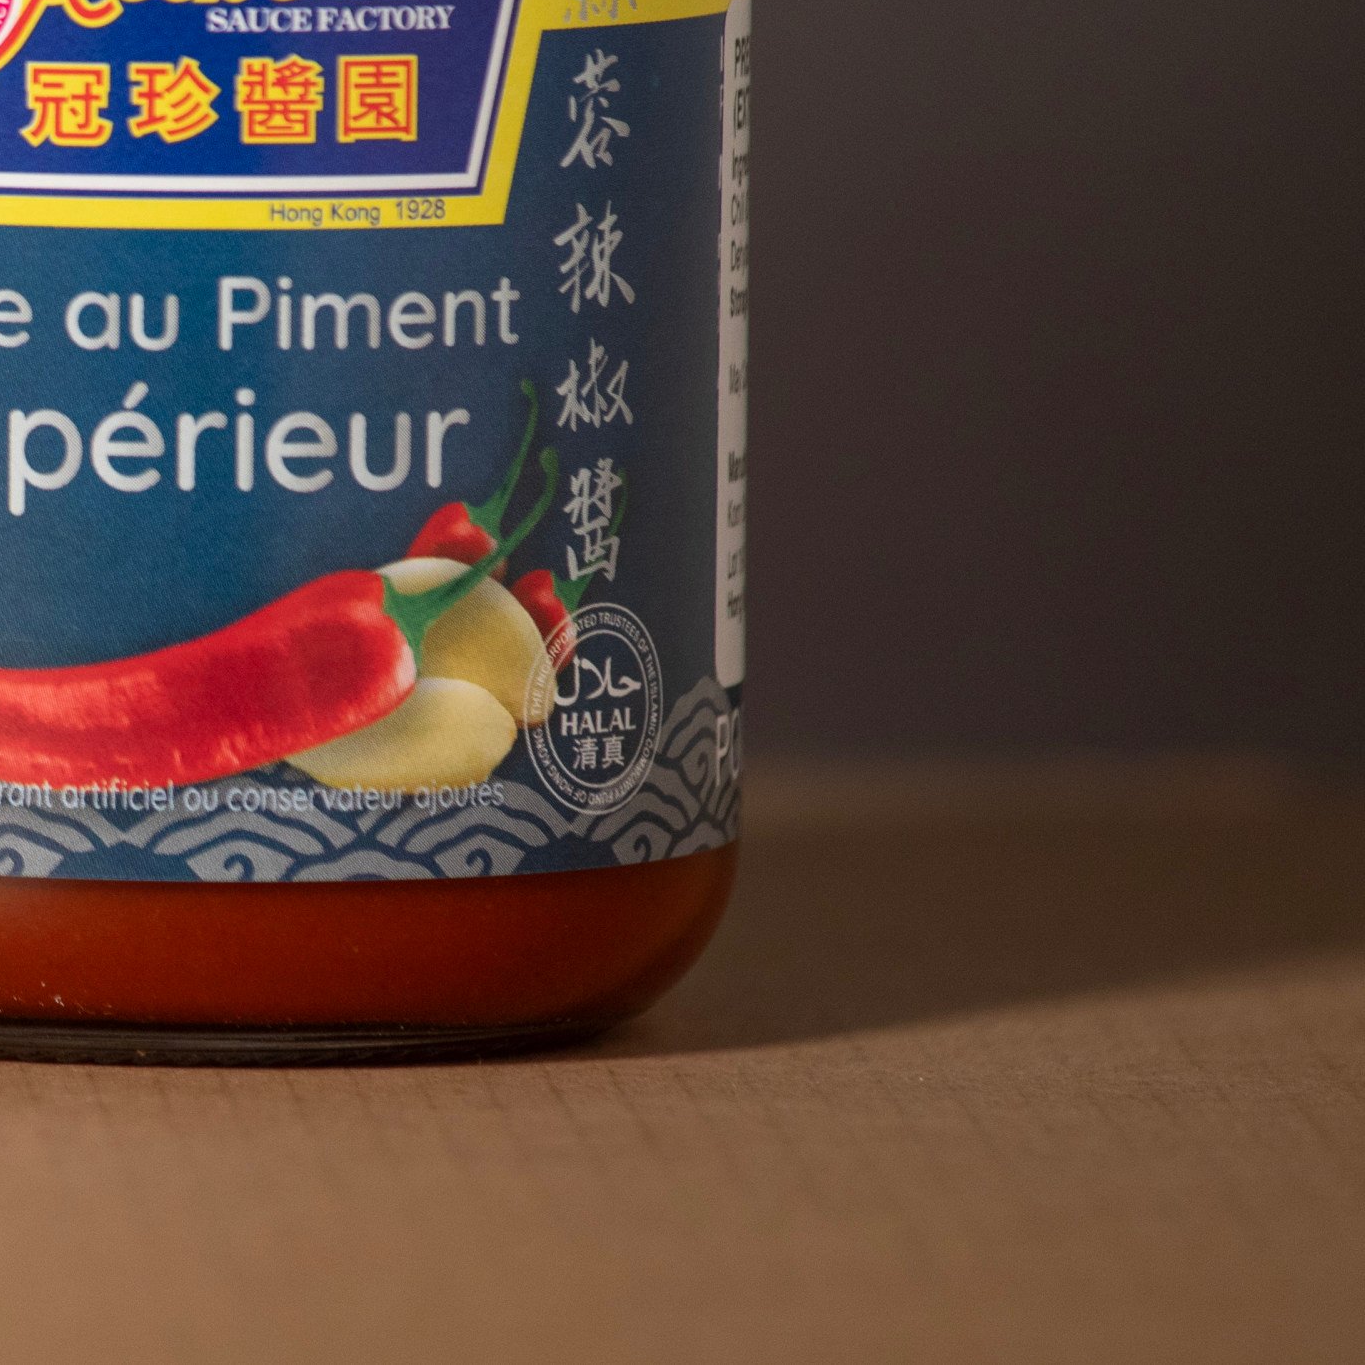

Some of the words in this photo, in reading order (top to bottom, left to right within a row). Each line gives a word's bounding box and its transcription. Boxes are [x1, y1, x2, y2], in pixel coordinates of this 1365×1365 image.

[206, 8, 313, 34] SAUCE
[318, 4, 456, 33] FACTORY
[19, 54, 419, 148] 冠珍醬園
[269, 203, 323, 227] Hong
[329, 202, 381, 226] Kong
[395, 198, 446, 222] 1928
[67, 290, 180, 352] au
[218, 275, 522, 352] Piment
[560, 707, 637, 737] HALAL
[572, 735, 626, 771] 清真
[60, 776, 175, 811] artificiel
[183, 786, 220, 812] ou
[226, 782, 407, 813] conservateur
[415, 779, 505, 816] ajoutés
